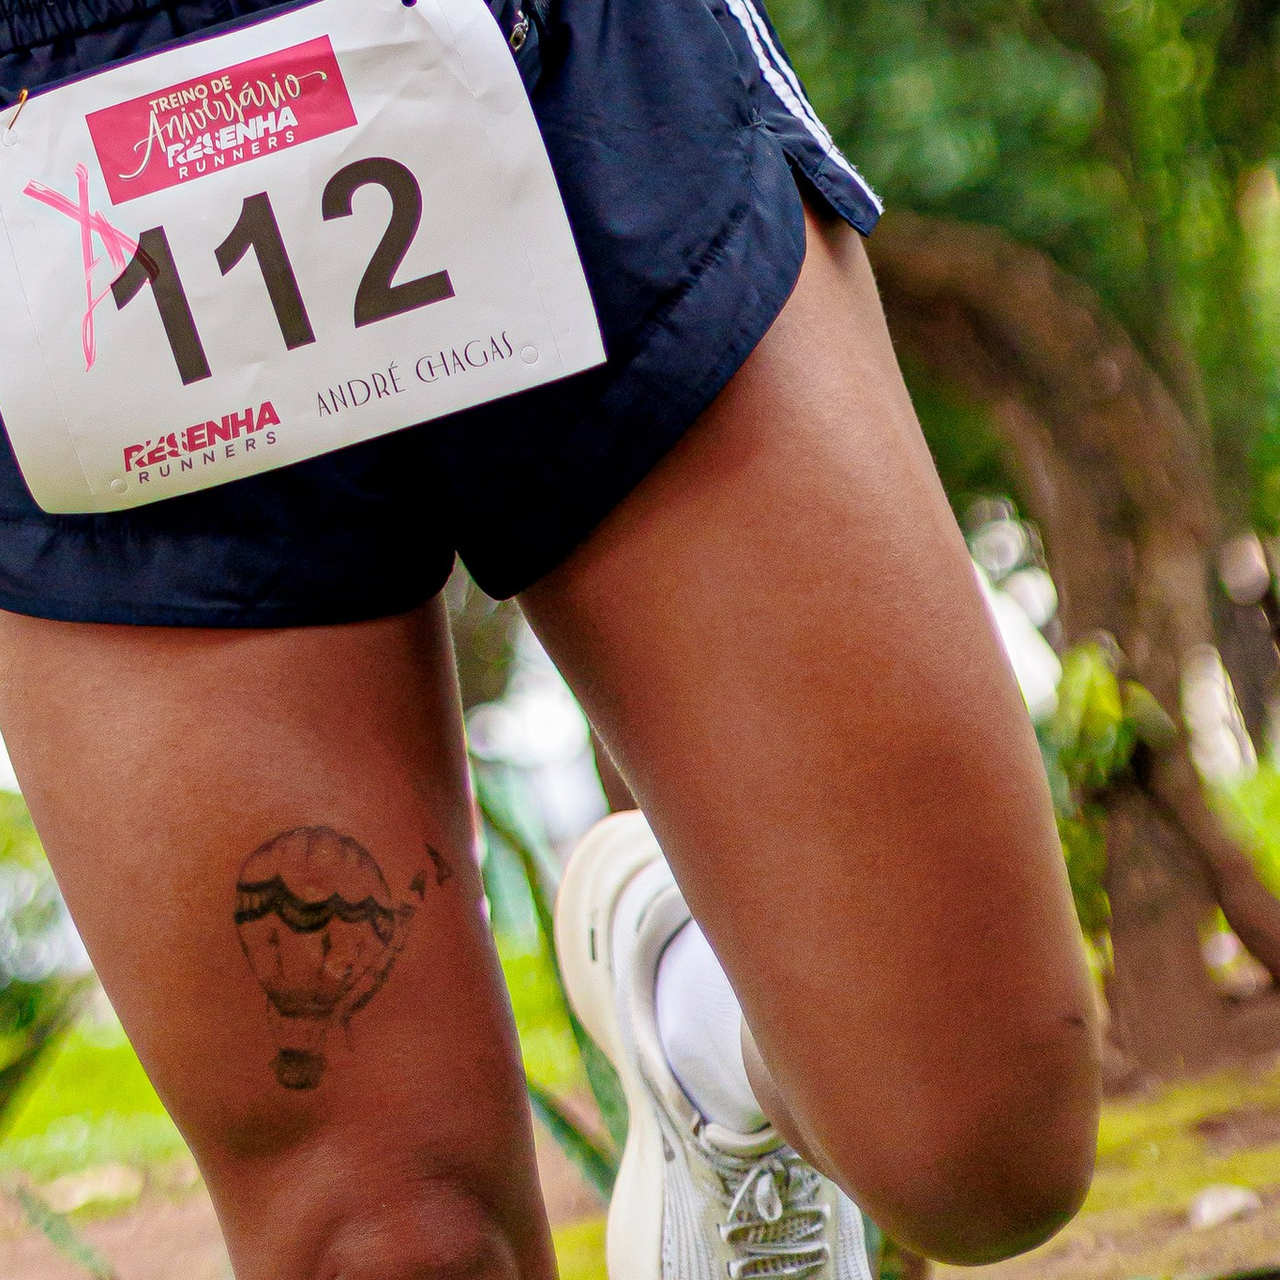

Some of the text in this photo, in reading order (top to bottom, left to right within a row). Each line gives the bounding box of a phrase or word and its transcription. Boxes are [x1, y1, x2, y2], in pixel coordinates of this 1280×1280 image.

[118, 71, 328, 180] Aniversário
[149, 75, 232, 115] TREINO DE
[167, 106, 298, 168] RESENHA
[178, 130, 295, 179] RUNNERS
[110, 156, 456, 386] 112
[316, 330, 514, 418] ANDRÉ CHAGAS
[123, 400, 281, 473] RESENHA
[138, 431, 278, 485] RUNNERS
